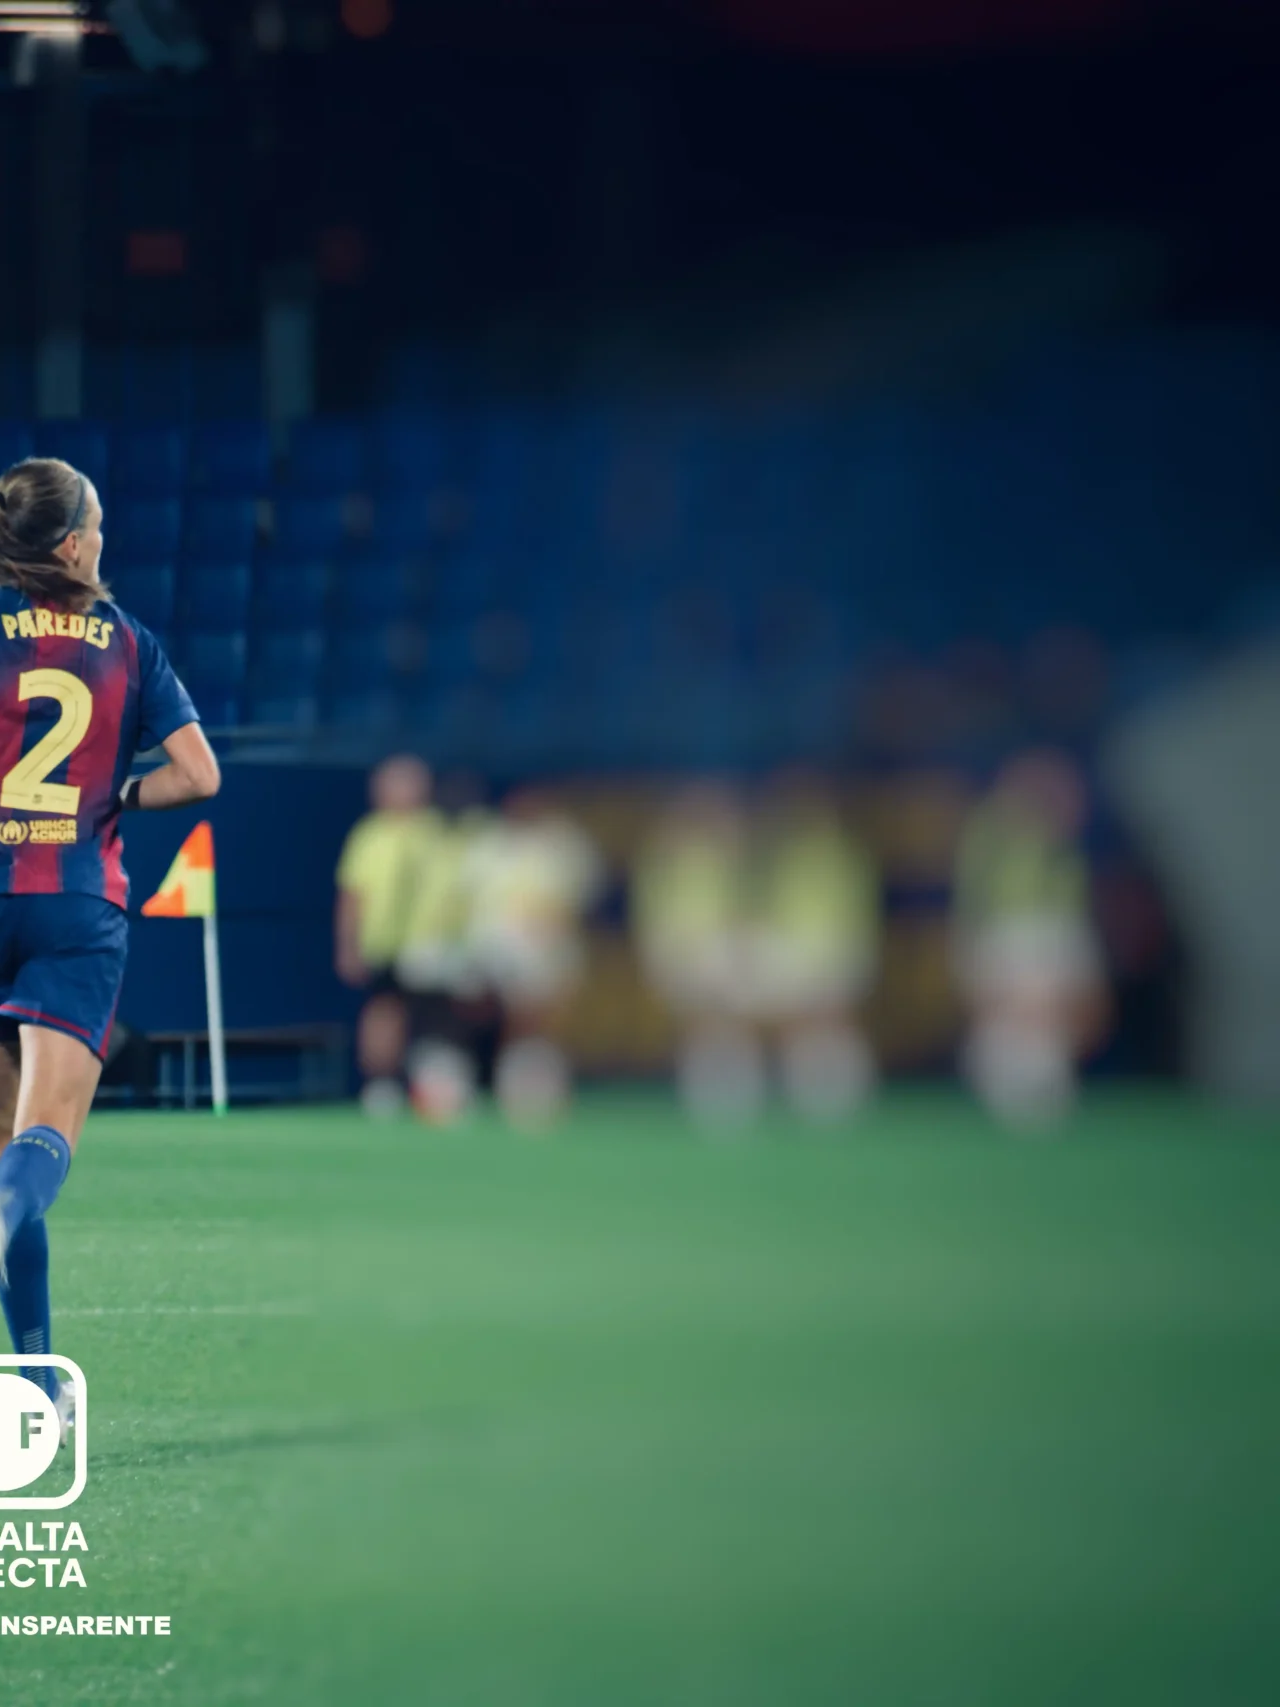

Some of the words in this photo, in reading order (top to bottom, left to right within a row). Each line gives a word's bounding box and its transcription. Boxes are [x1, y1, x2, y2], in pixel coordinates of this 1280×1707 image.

[1, 608, 114, 649] PAREDES
[0, 668, 92, 815] 2
[29, 819, 77, 831] UNHCR
[29, 830, 77, 843] ACNUR
